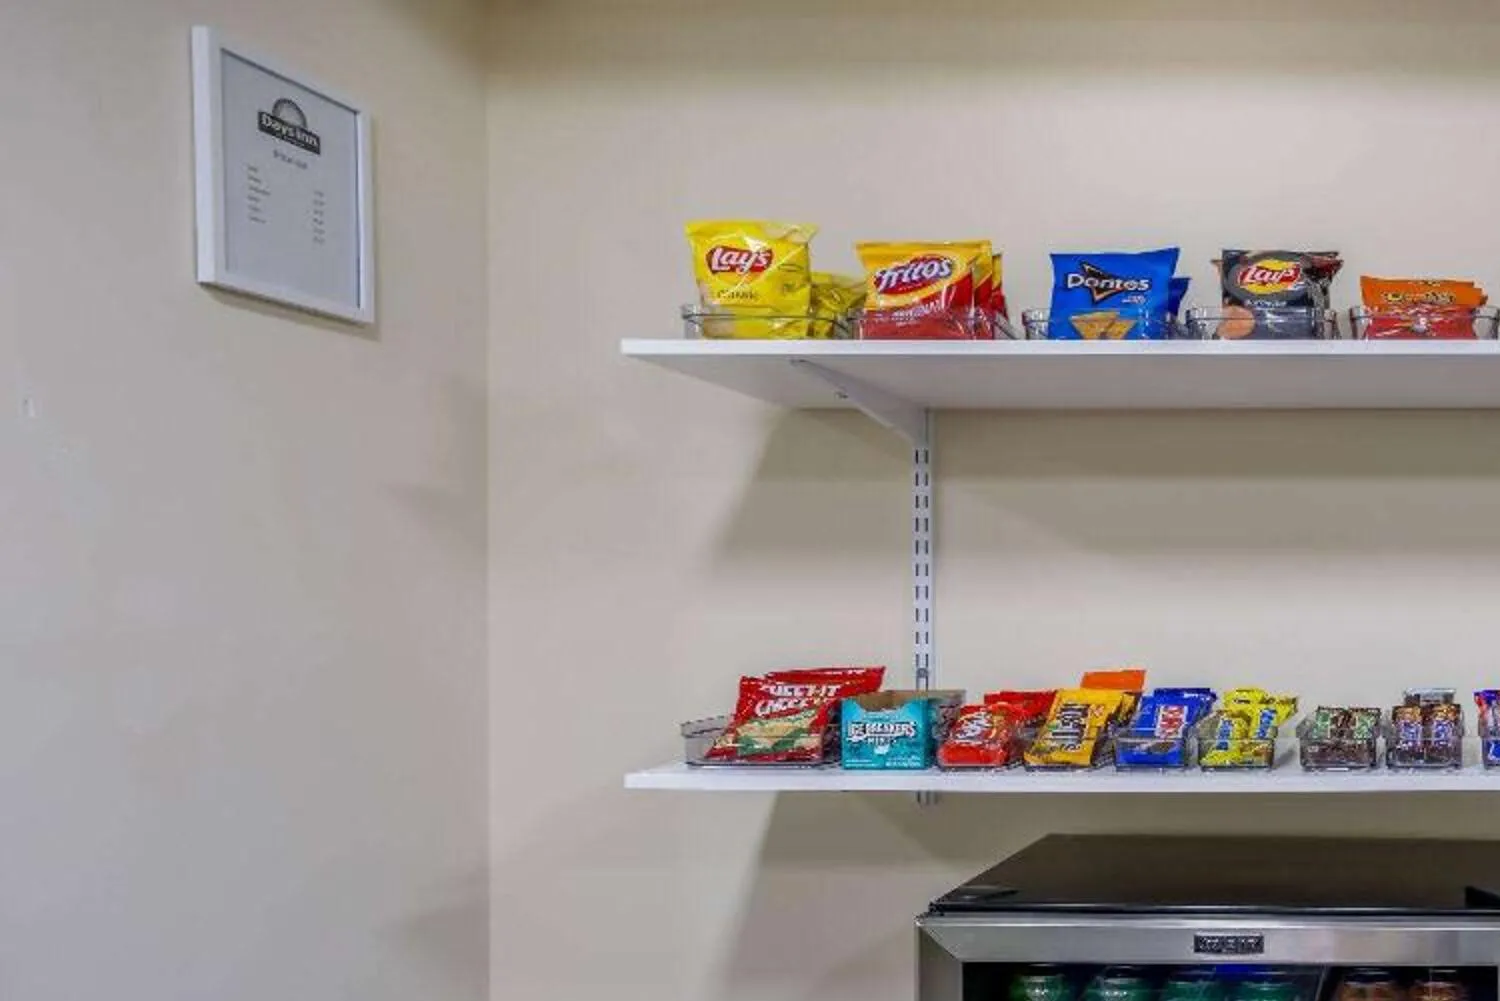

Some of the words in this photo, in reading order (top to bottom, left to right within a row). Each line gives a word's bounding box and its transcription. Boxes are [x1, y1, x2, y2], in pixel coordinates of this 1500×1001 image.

[262, 114, 293, 139] Days
[709, 246, 773, 274] Lay's
[874, 257, 953, 290] Fritos
[1066, 271, 1150, 291] Doritos
